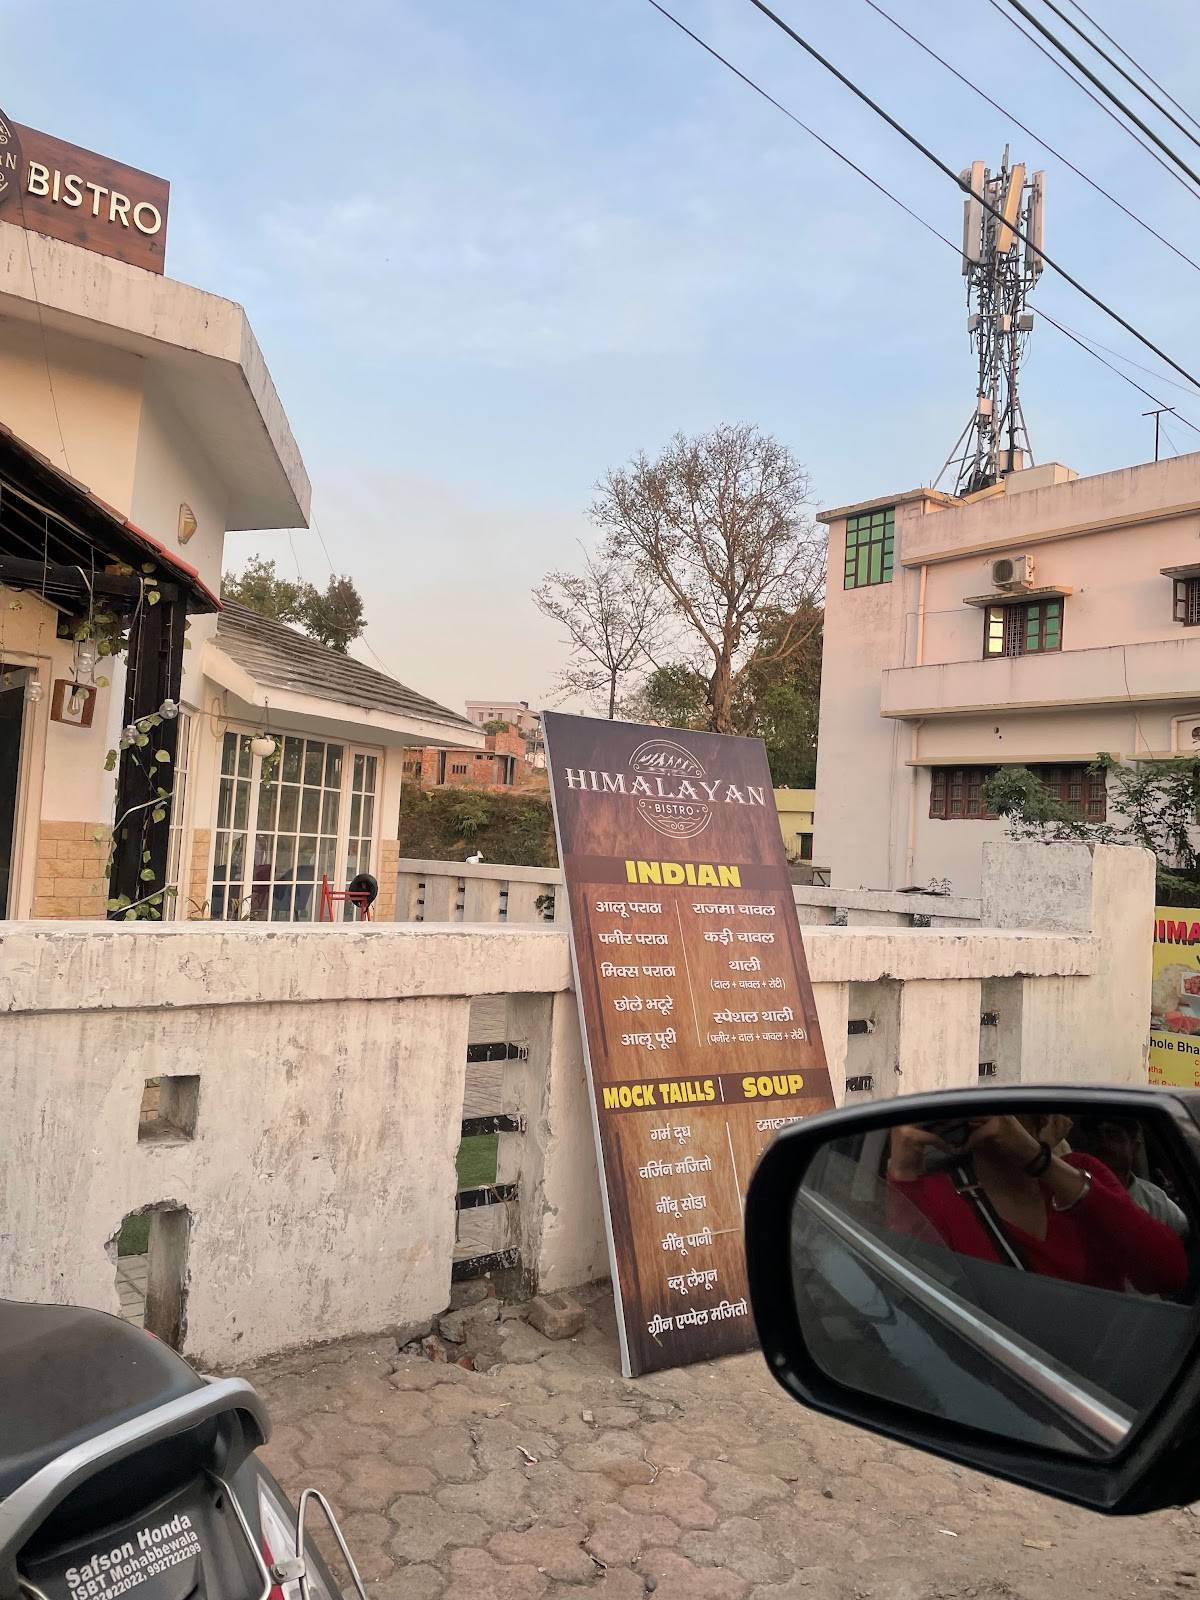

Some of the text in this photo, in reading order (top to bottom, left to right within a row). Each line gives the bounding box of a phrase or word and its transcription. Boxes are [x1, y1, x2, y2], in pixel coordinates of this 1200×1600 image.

[28, 161, 162, 235] BISTRO
[565, 768, 767, 806] HIMALAYAN
[654, 803, 694, 816] BISTRO
[625, 860, 742, 888] INDIAN
[596, 901, 662, 918] आलू पराठा
[692, 903, 776, 916] राजमा चावल
[598, 929, 668, 945] पनीर पराठा
[736, 932, 775, 944] चावल
[1154, 920, 1200, 946] IMA
[600, 961, 676, 978] मिक्स पराठा
[728, 956, 761, 971] थाली
[613, 995, 674, 1015] छोले भटूरे
[713, 1006, 794, 1023] स्पेशल थाली
[621, 1027, 676, 1050] आलू पूरी
[602, 1080, 715, 1109] MOCK TAILLS
[742, 1074, 804, 1098] SOUP
[650, 1122, 692, 1145] गर्म दूध
[639, 1155, 712, 1179] वर्जिन मजितो
[656, 1192, 707, 1219] नींबू सोडा
[661, 1226, 713, 1256] नींबू पानी
[667, 1274, 689, 1296] ब्लू
[647, 1313, 673, 1338] ग्रीन
[709, 1298, 748, 1322] मजितो
[65, 1514, 192, 1589] Safson Honda
[147, 1542, 201, 1577] 9927222299
[71, 1531, 198, 1600] ISBT Mohabbewala
